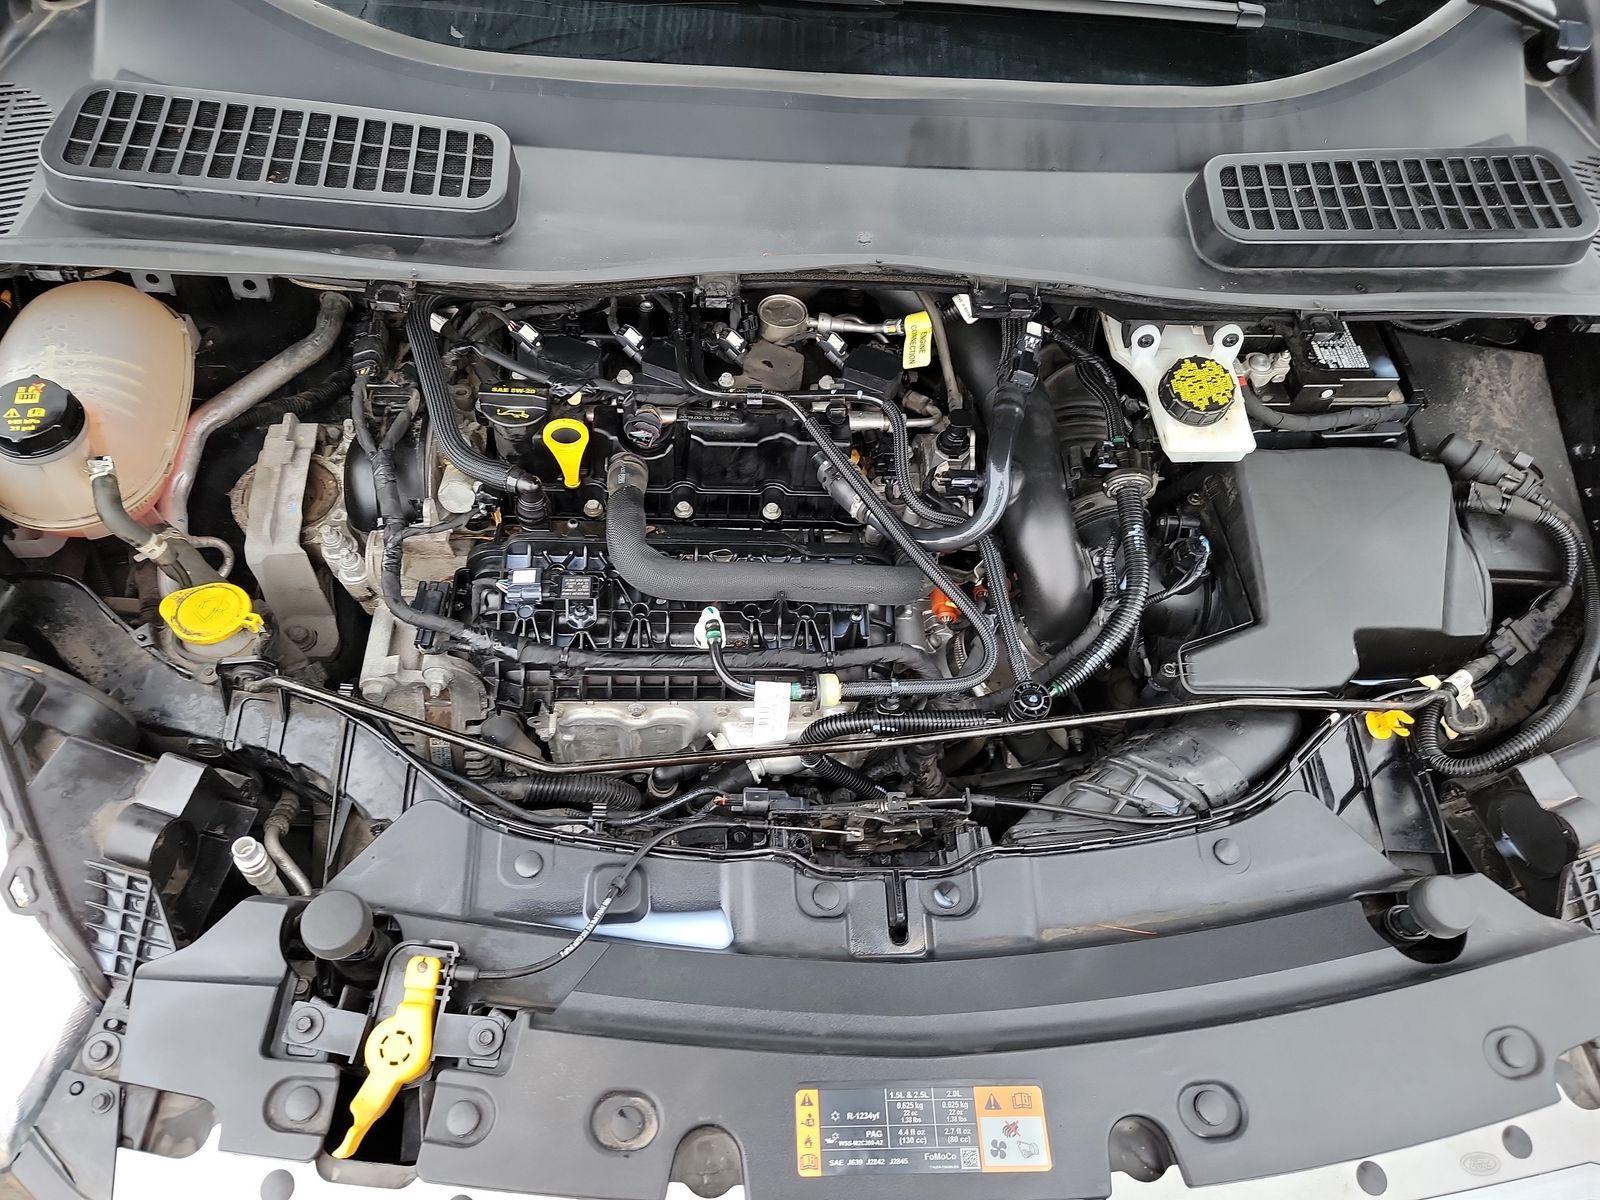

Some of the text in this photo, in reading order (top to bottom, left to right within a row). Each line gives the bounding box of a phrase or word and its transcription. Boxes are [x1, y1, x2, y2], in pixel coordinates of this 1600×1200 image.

[919, 331, 927, 354] ENGINE
[896, 1102, 924, 1110] 0.625 kg
[960, 1100, 968, 1110] kg
[846, 1112, 880, 1121] R-1234yf
[899, 1136, 926, 1145] (130 cc)
[948, 1136, 970, 1144] (80 cc)
[924, 1152, 956, 1160] FoMoCo
